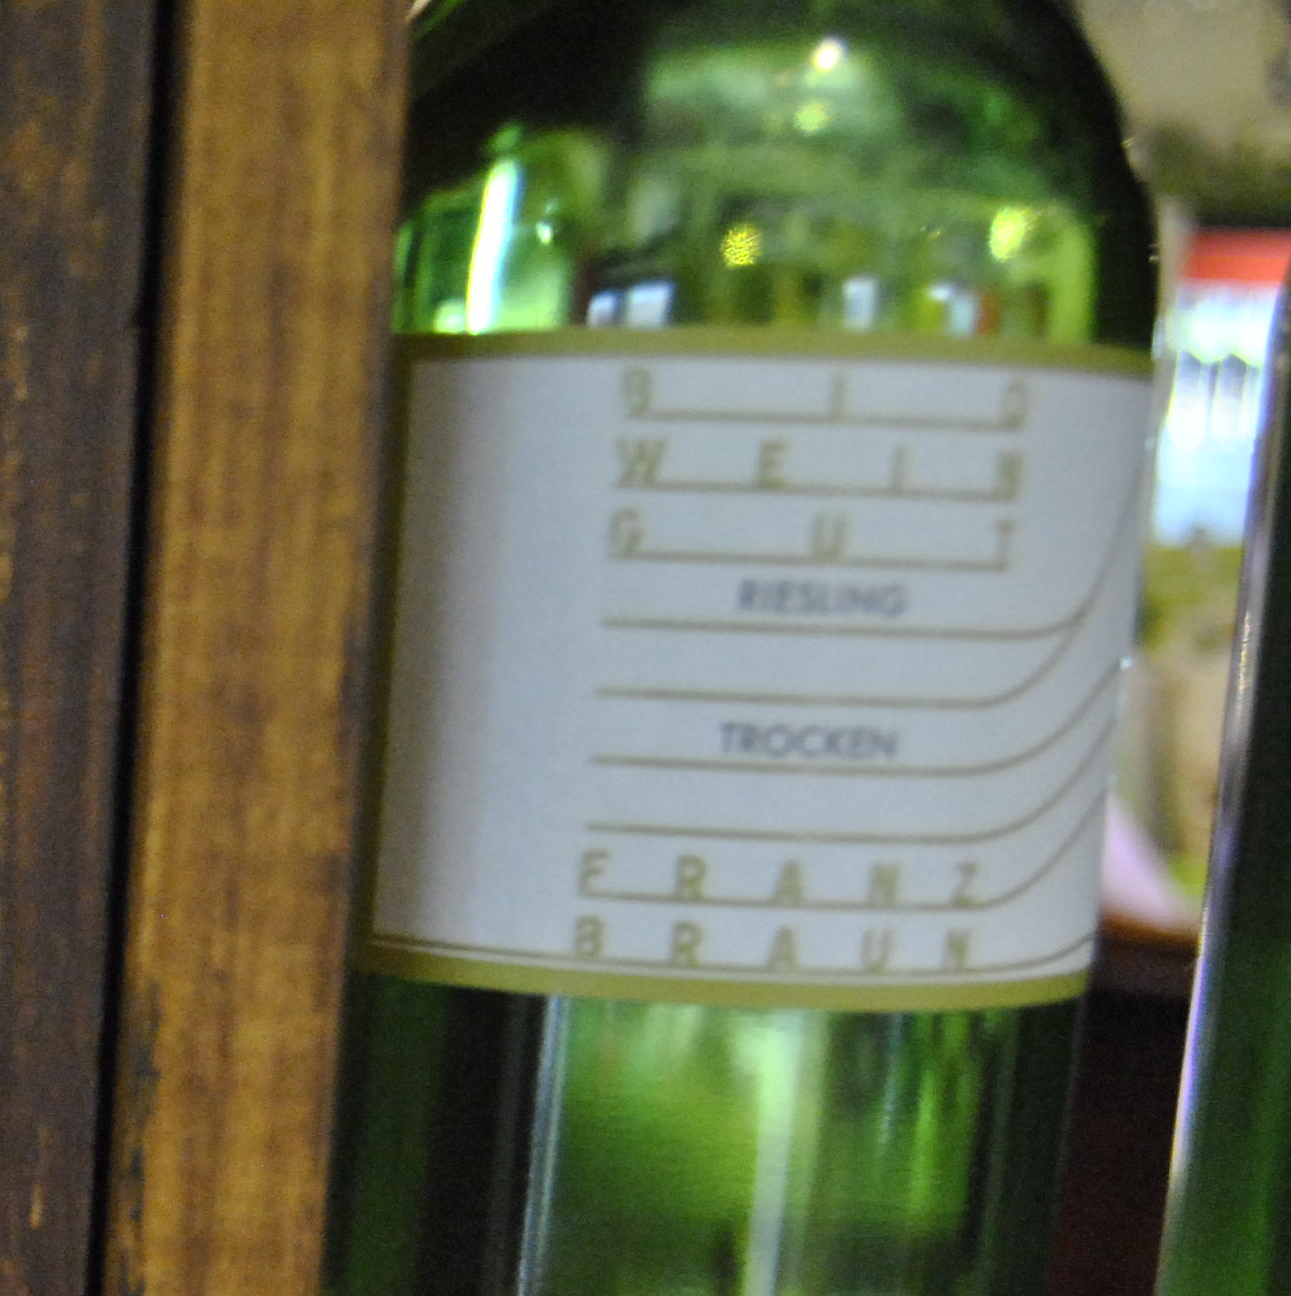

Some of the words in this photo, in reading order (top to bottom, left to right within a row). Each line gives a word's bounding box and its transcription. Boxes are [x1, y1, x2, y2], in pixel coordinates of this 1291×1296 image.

[609, 507, 1016, 570] GUT
[737, 577, 909, 618] RIESLING
[721, 720, 899, 760] TROCKEN
[577, 848, 981, 908] FRANZ
[573, 914, 973, 973] BRAUN
